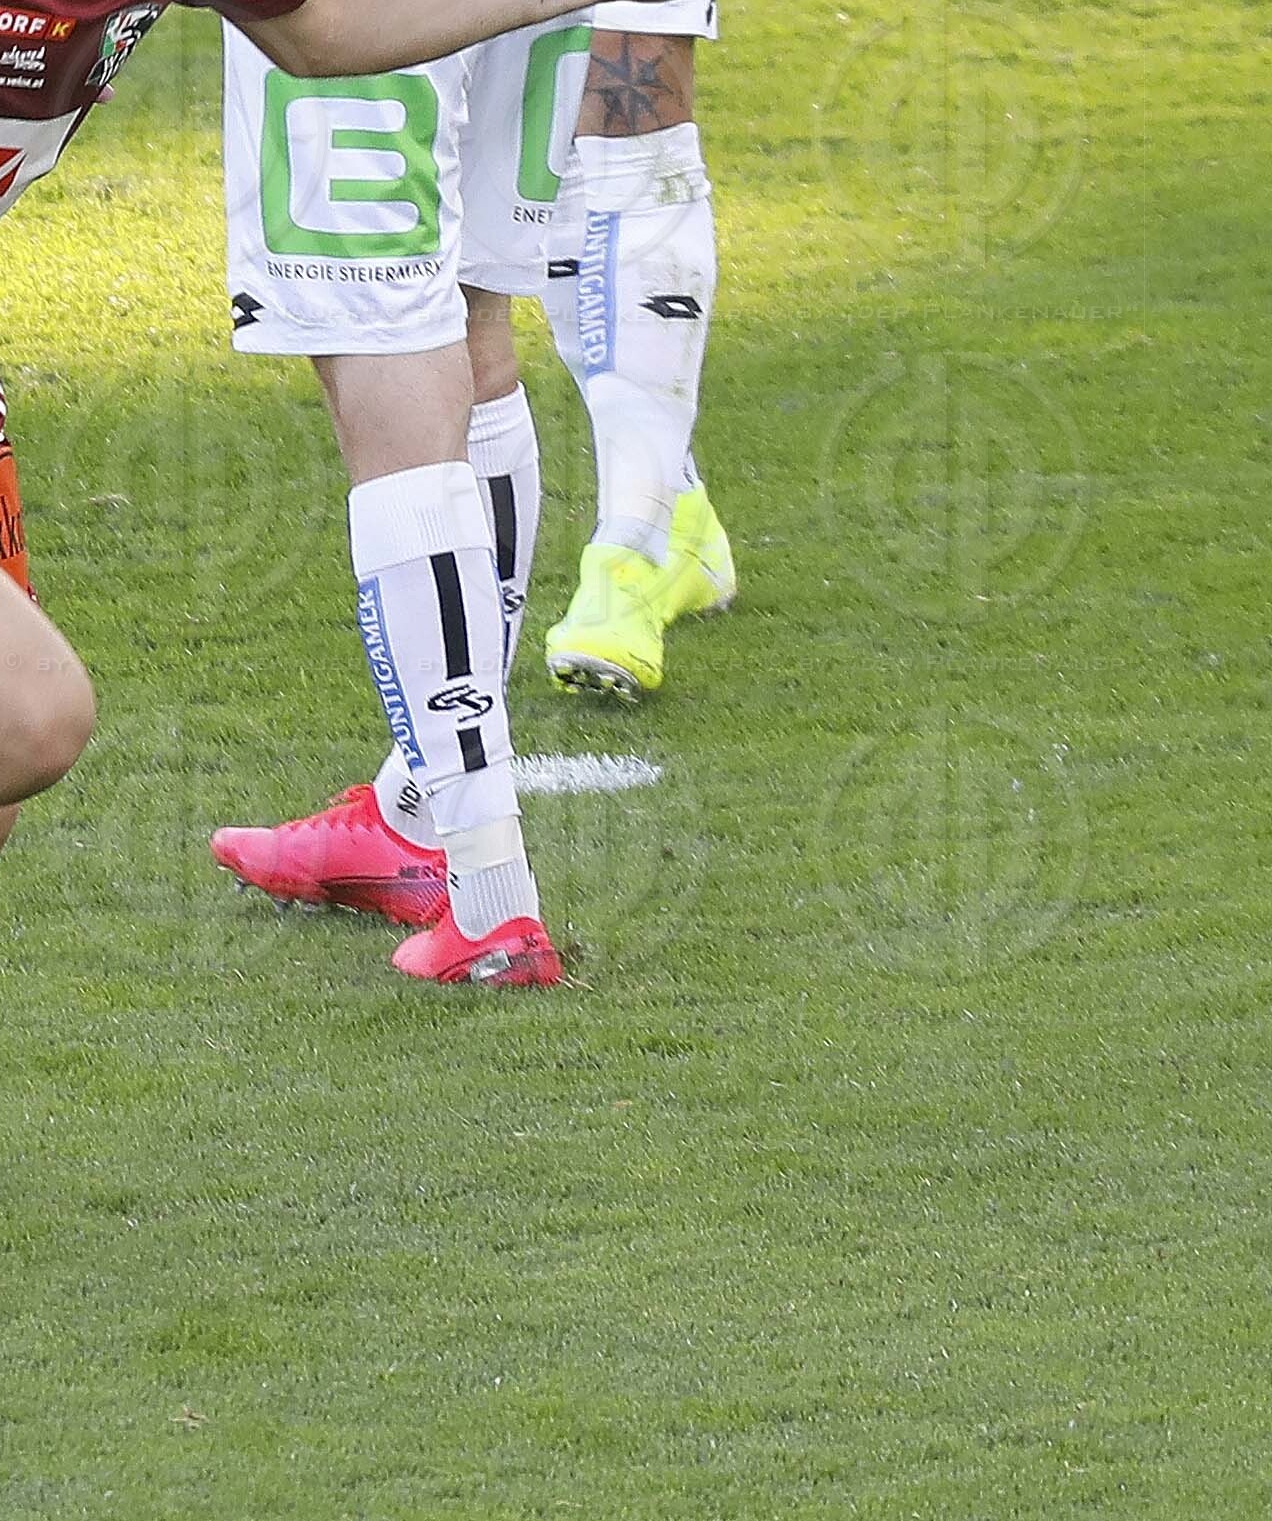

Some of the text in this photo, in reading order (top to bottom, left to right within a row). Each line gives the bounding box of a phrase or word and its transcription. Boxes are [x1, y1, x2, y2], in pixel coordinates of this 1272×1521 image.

[52, 20, 70, 37] K
[267, 260, 334, 280] ENERGIE
[359, 589, 419, 761] PUNTIGAMER
